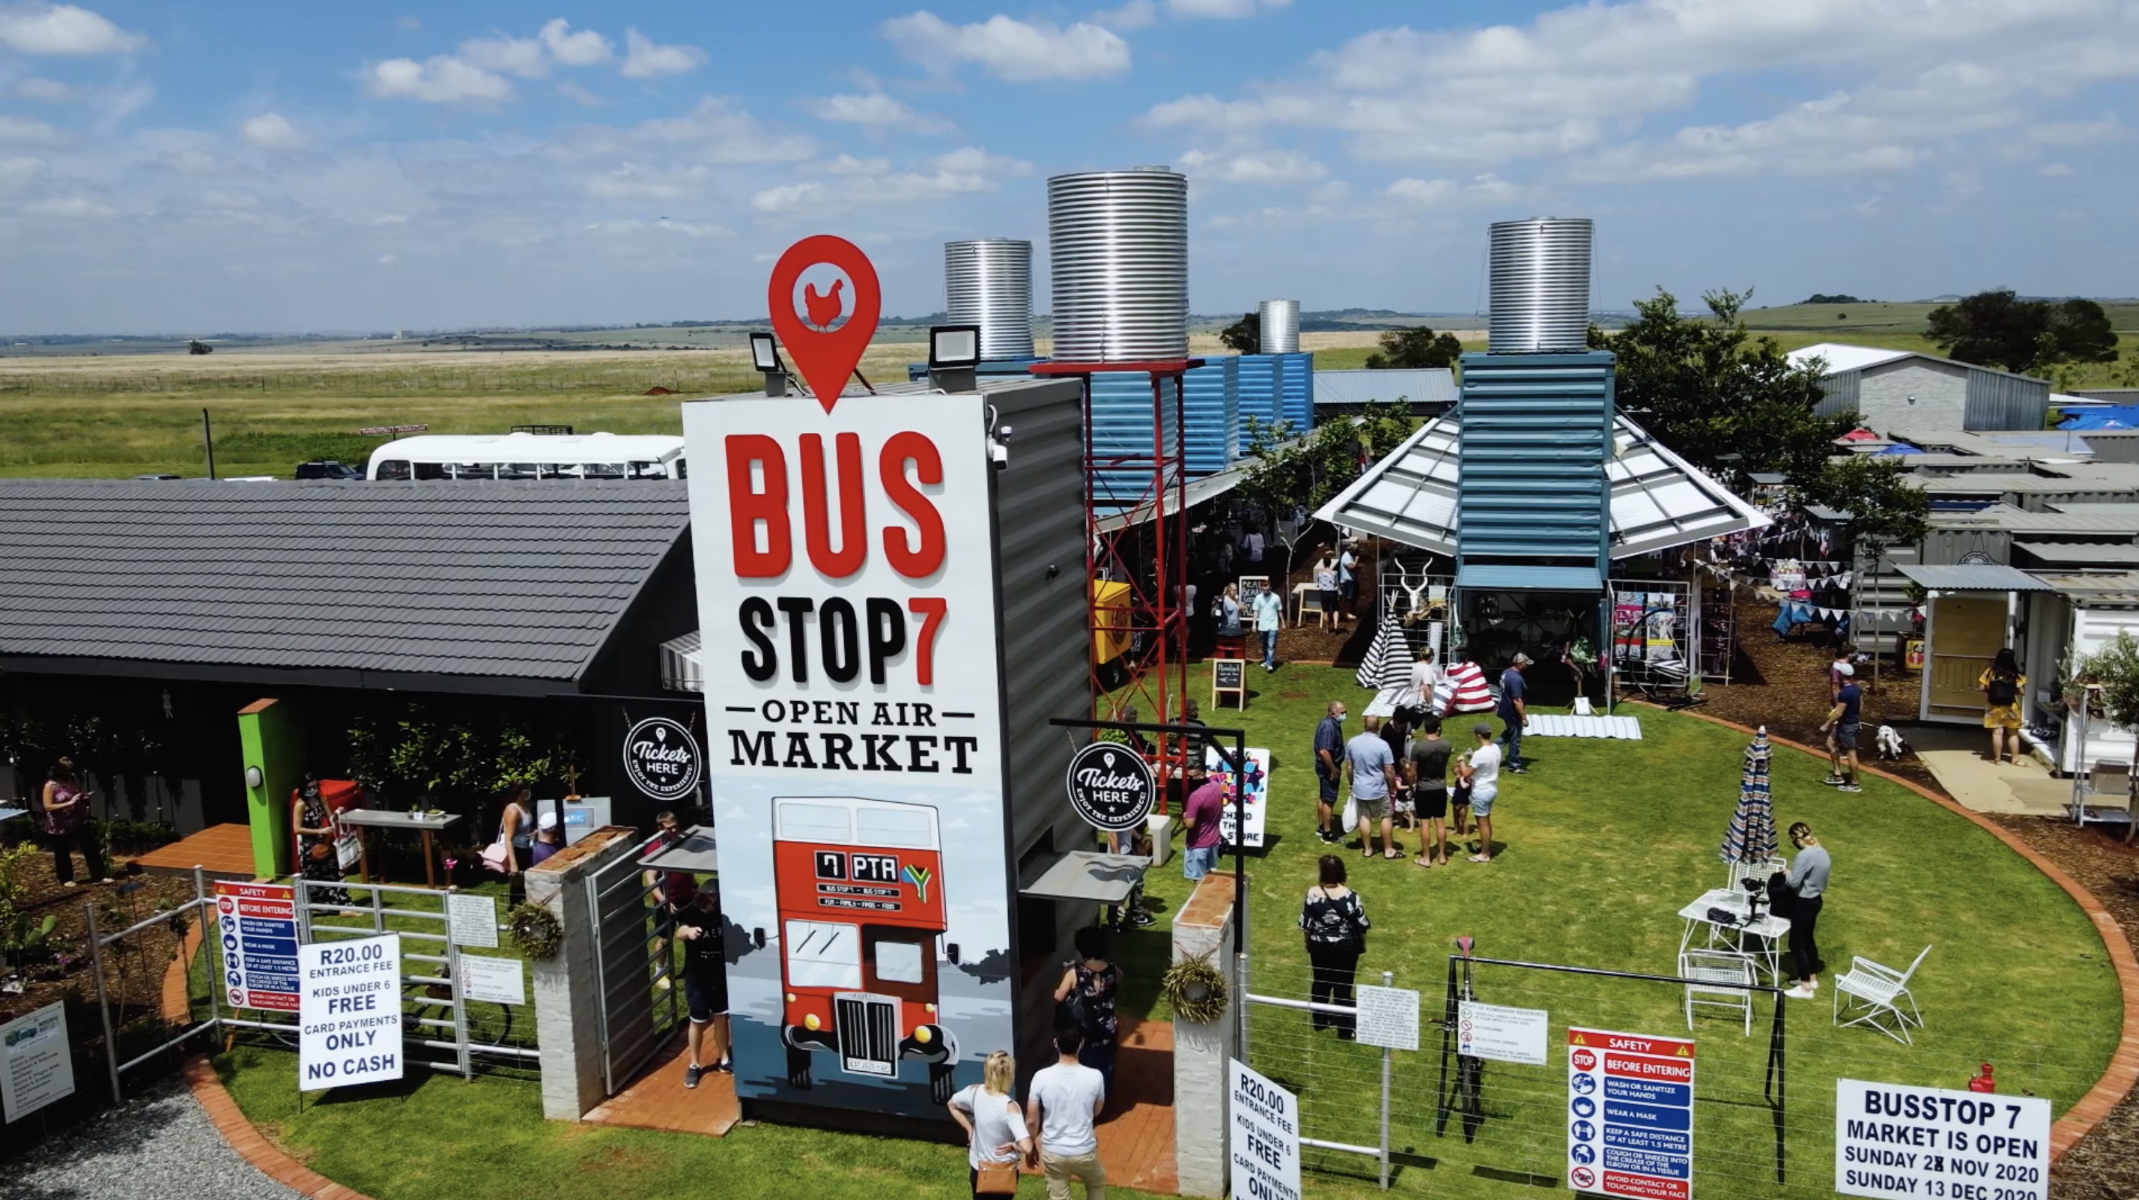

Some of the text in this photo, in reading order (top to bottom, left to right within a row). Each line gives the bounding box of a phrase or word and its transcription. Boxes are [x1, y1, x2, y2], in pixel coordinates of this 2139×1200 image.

[725, 431, 947, 578] BUS
[762, 699, 936, 726] OPEN AIR
[633, 741, 691, 763] Tickets
[728, 729, 977, 774] MARKET
[632, 759, 646, 780] ENJOY
[646, 779, 659, 790] THE
[647, 762, 679, 774] HERE
[1077, 768, 1144, 791] Tickets
[1077, 788, 1092, 810] ENJOY
[1092, 809, 1107, 821] THE
[1093, 790, 1129, 803] HERE
[853, 857, 896, 880] PTA
[239, 888, 266, 896] SAFETY
[219, 901, 232, 909] STOP
[240, 904, 293, 914] BEFORE ENTERING
[320, 944, 382, 965] R20.00
[309, 960, 393, 979] ENTRANCE FEE
[313, 980, 391, 998] KIDS UNDER 6
[328, 994, 376, 1015] FREE
[304, 1015, 398, 1035] CARD PAYMENTS
[326, 1030, 377, 1051] ONLY
[1609, 1038, 1652, 1052] SAFETY
[308, 1054, 395, 1080] NO CASH
[1574, 1054, 1594, 1066] STOP
[1606, 1059, 1691, 1077] BEFORE ENTERING
[1241, 1073, 1283, 1115] R20.00
[1607, 1080, 1676, 1094] WASH OR SANITIZE
[1607, 1088, 1656, 1100] YOUR HANDS
[1234, 1090, 1293, 1135] ENTRANCE FEE
[1606, 1109, 1628, 1117] WEAR
[1636, 1112, 1657, 1121] MASK
[1865, 1090, 2021, 1129] BUSSTOP 7
[1237, 1114, 1291, 1156] KIDS UNDER 6
[1606, 1128, 1623, 1136] KEEP
[1630, 1131, 1648, 1139] SAFE
[1649, 1132, 1685, 1143] DISTANCE
[1617, 1136, 1626, 1144] AT
[1627, 1137, 1649, 1147] LEAST
[1651, 1140, 1662, 1148] 1.5
[1663, 1142, 1687, 1151] METRE
[1847, 1119, 2038, 1159] MARKET IS OPEN
[1248, 1134, 1281, 1171] FREE
[1606, 1149, 1631, 1158] COUGH
[1644, 1153, 1668, 1163] SNEEZE
[1670, 1156, 1688, 1165] INTO
[1620, 1156, 1644, 1166] CREASE
[1645, 1159, 1656, 1167] OF
[1657, 1160, 1669, 1169] THE
[1606, 1161, 1629, 1170] ELBOW
[1630, 1163, 1641, 1171] OR
[1657, 1166, 1679, 1176] TISSUE
[1845, 1145, 1917, 1171] SUNDAY
[1950, 1158, 1989, 1178] NOV
[1995, 1163, 2039, 1184] 2020
[1234, 1153, 1299, 1200] CARD PAYMENTS
[1606, 1174, 1678, 1189] AVOID CONTACT OR
[1846, 1169, 2038, 1200] SUNDAY 13 DEC 2020
[1606, 1182, 1686, 1199] TOUCHING YOUR FACE
